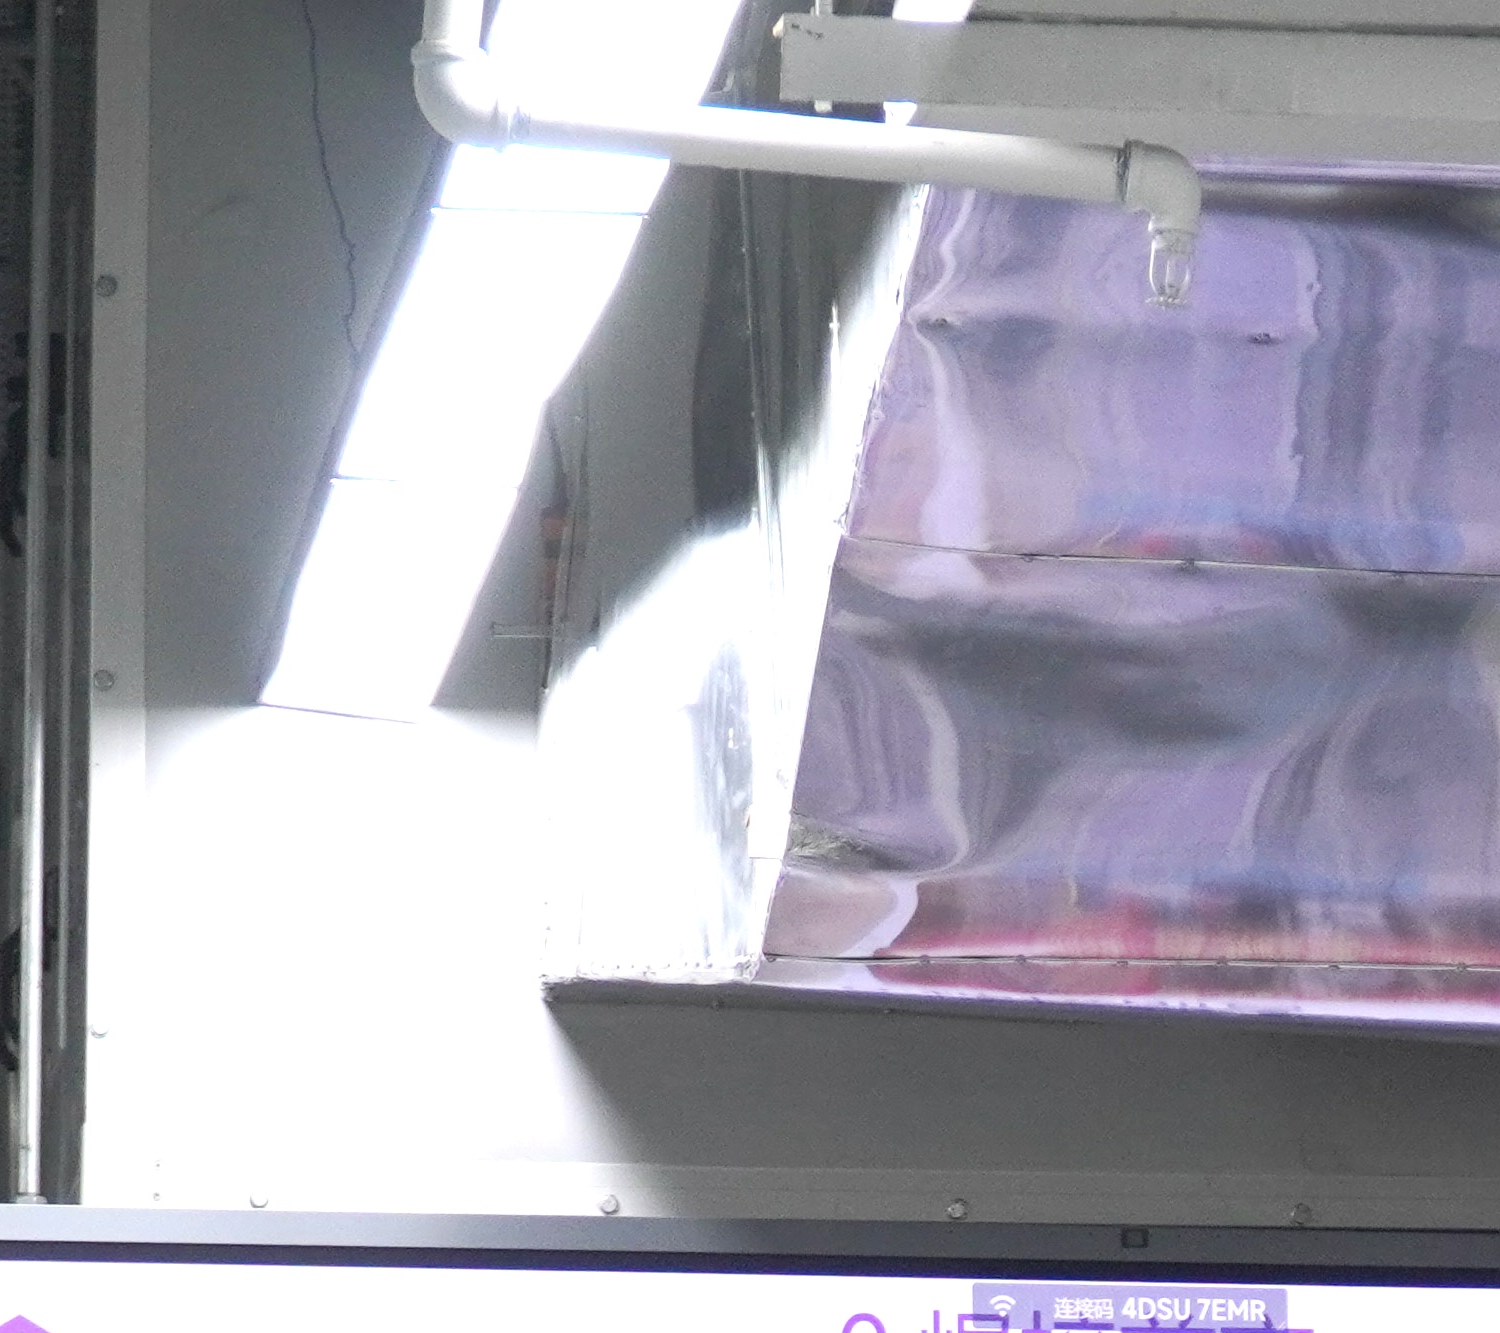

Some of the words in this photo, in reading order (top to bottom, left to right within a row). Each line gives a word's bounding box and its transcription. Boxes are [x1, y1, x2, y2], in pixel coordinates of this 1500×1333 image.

[1053, 1296, 1114, 1321] 连接码
[1121, 1296, 1191, 1322] 4DSU
[1197, 1298, 1267, 1323] 7EMR
